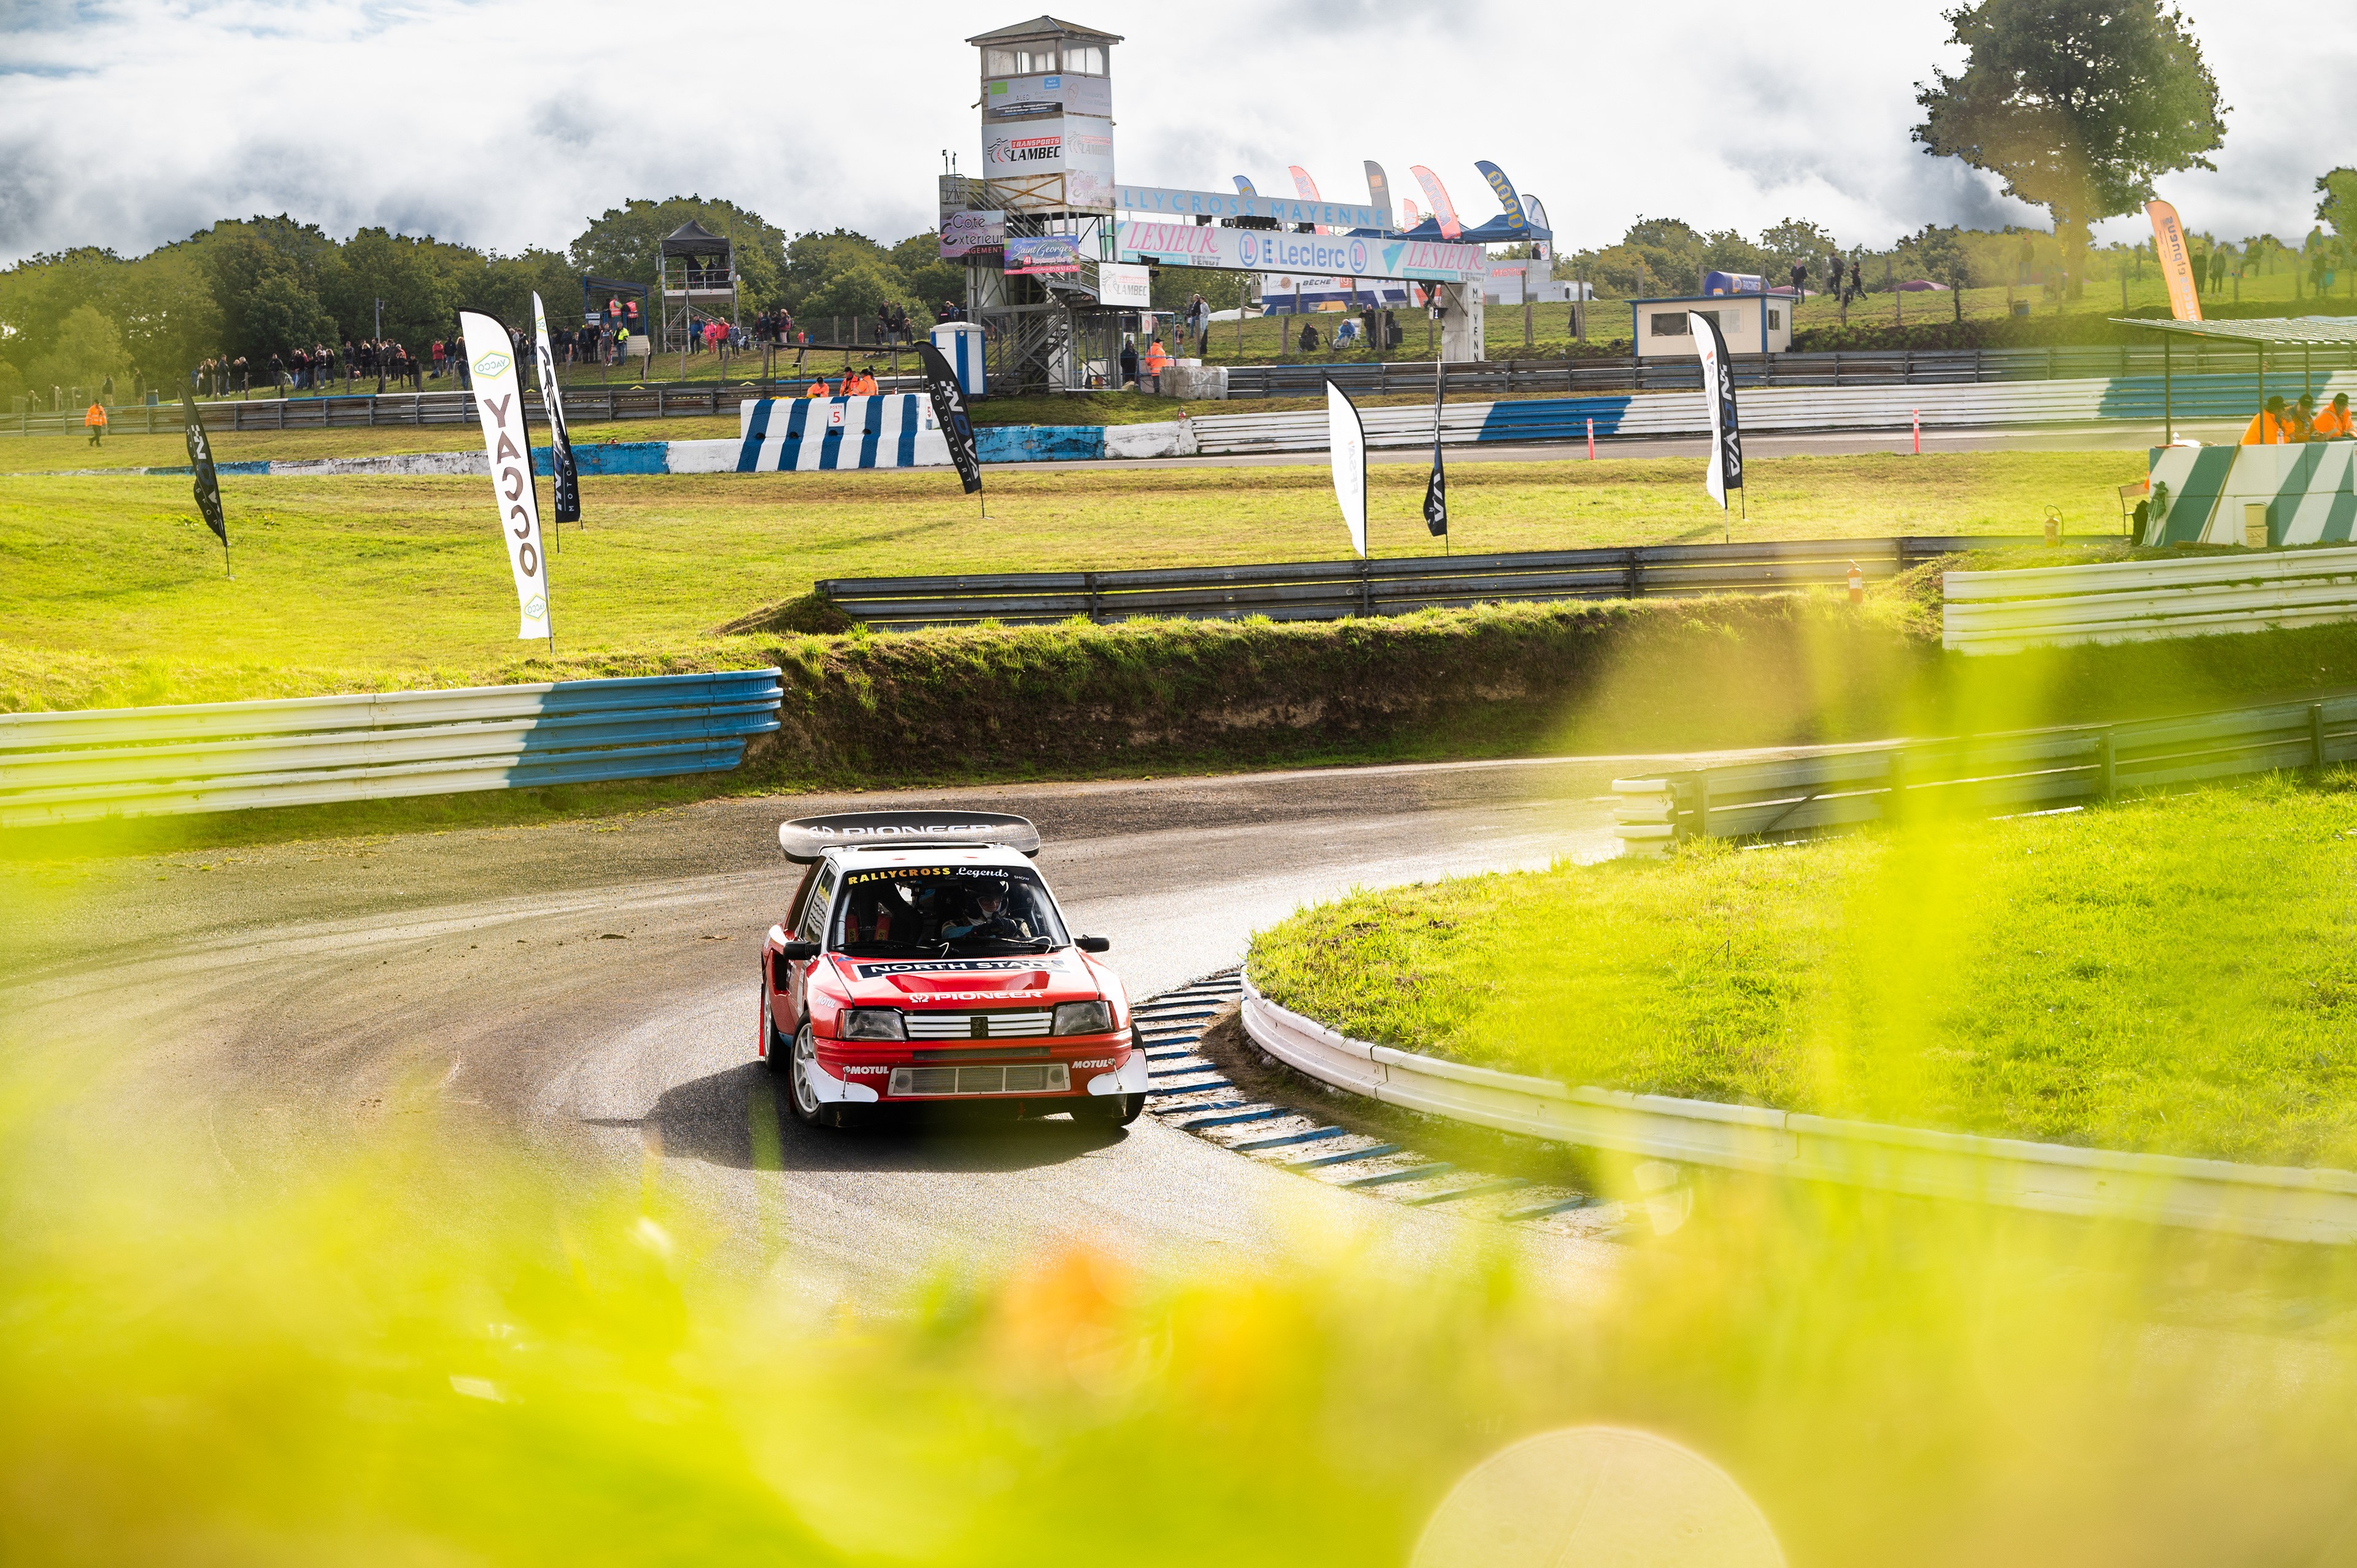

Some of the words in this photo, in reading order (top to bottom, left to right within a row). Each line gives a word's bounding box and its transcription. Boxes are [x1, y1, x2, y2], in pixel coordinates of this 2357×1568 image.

[1012, 137, 1060, 148] TRANSPORTS
[1010, 145, 1061, 162] LAMBEC
[1081, 144, 1111, 156] LAMBEC
[1115, 190, 1255, 216] LLYCROSS
[1271, 201, 1384, 226] MAYENNE
[953, 214, 986, 229] Côté
[940, 222, 1005, 245] Extérieur
[1127, 222, 1220, 253] LESIEUR
[1012, 244, 1037, 258] Saint
[1036, 243, 1074, 258] Georges
[1263, 239, 1345, 268] E.Leclerc
[1407, 242, 1485, 270] LESIEUR
[1191, 255, 1221, 266] FENDT
[1117, 284, 1147, 296] LAMBEC
[832, 411, 841, 423] 5
[927, 406, 932, 418] 5
[929, 383, 972, 482] MOTORSPORT
[940, 380, 979, 480] NOVA
[842, 825, 994, 837] PIONEER
[848, 867, 951, 886] RALLYCROSS
[958, 867, 1009, 878] Legends
[869, 962, 969, 973] NORTH
[815, 995, 837, 1009] MOTUL
[934, 992, 1043, 1000] PIONEER
[850, 1065, 889, 1075] MOTUL
[1072, 1059, 1109, 1069] MOTUL
